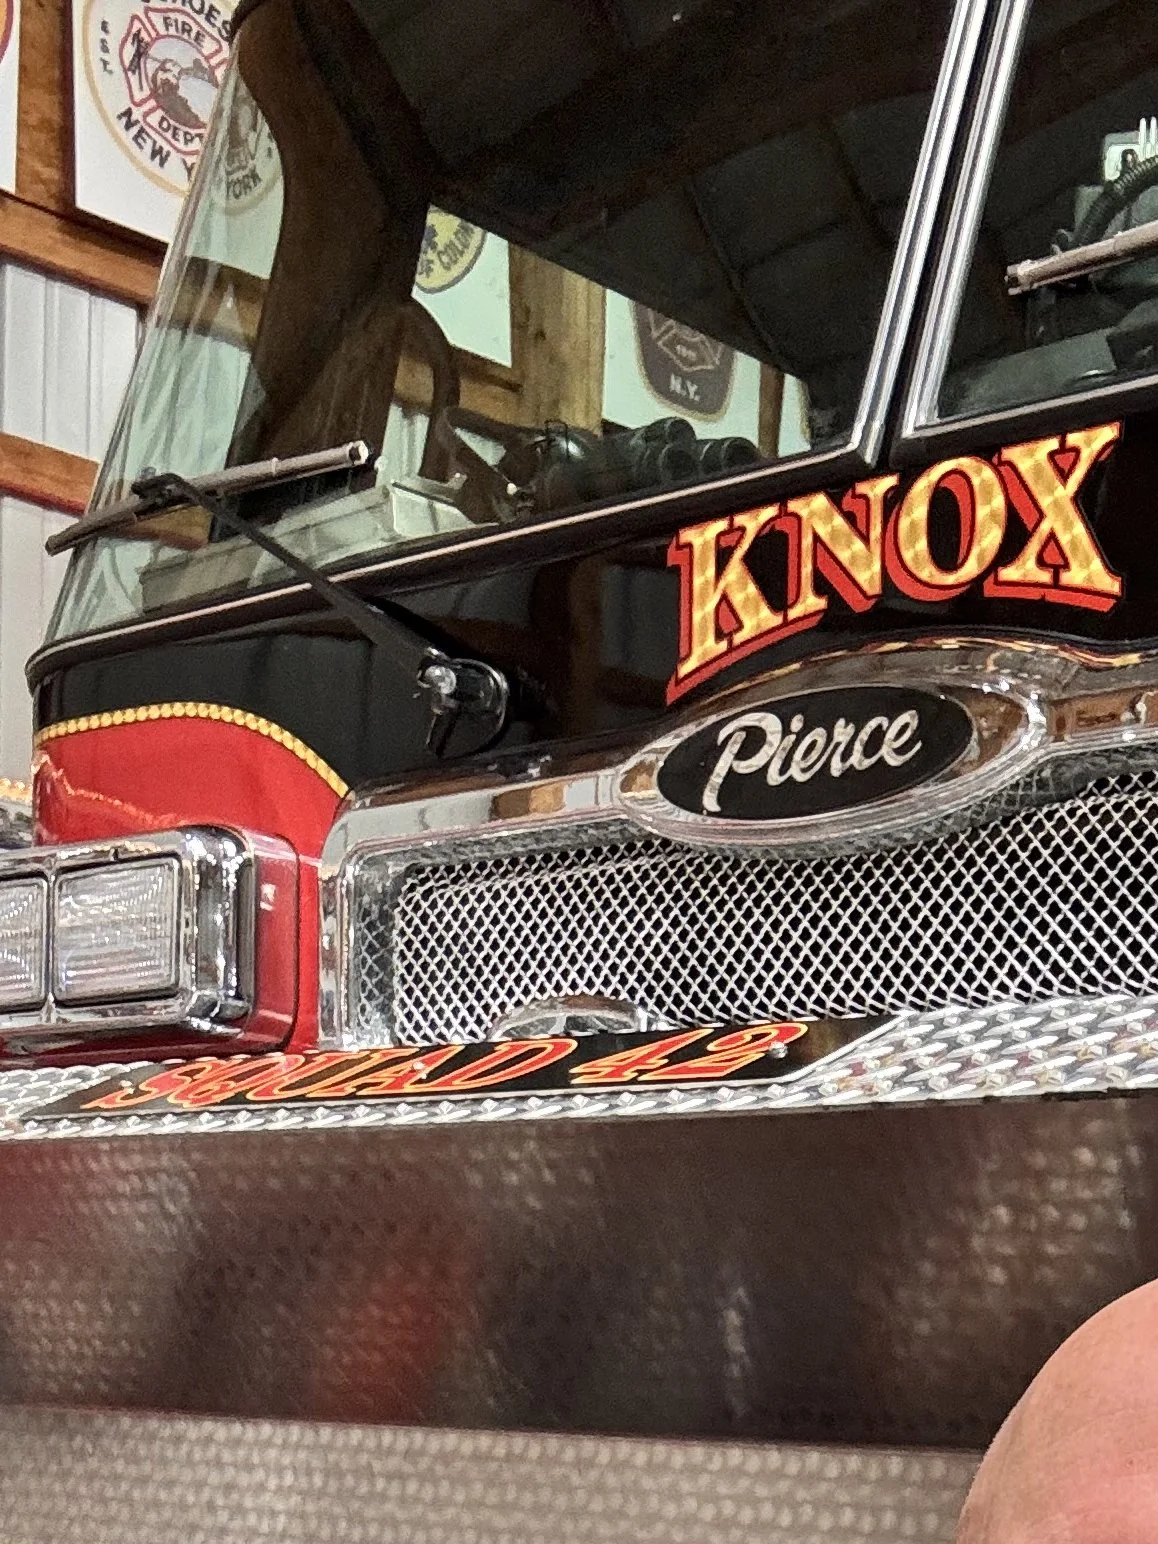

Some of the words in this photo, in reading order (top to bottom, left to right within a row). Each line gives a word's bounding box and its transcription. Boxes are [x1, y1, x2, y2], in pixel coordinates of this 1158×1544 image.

[162, 15, 206, 48] FIRE
[117, 106, 172, 168] NEW
[667, 421, 1123, 705] KNOX
[702, 709, 923, 813] Pierce
[80, 1038, 578, 1109] SQUAD
[568, 1022, 808, 1084] 42
